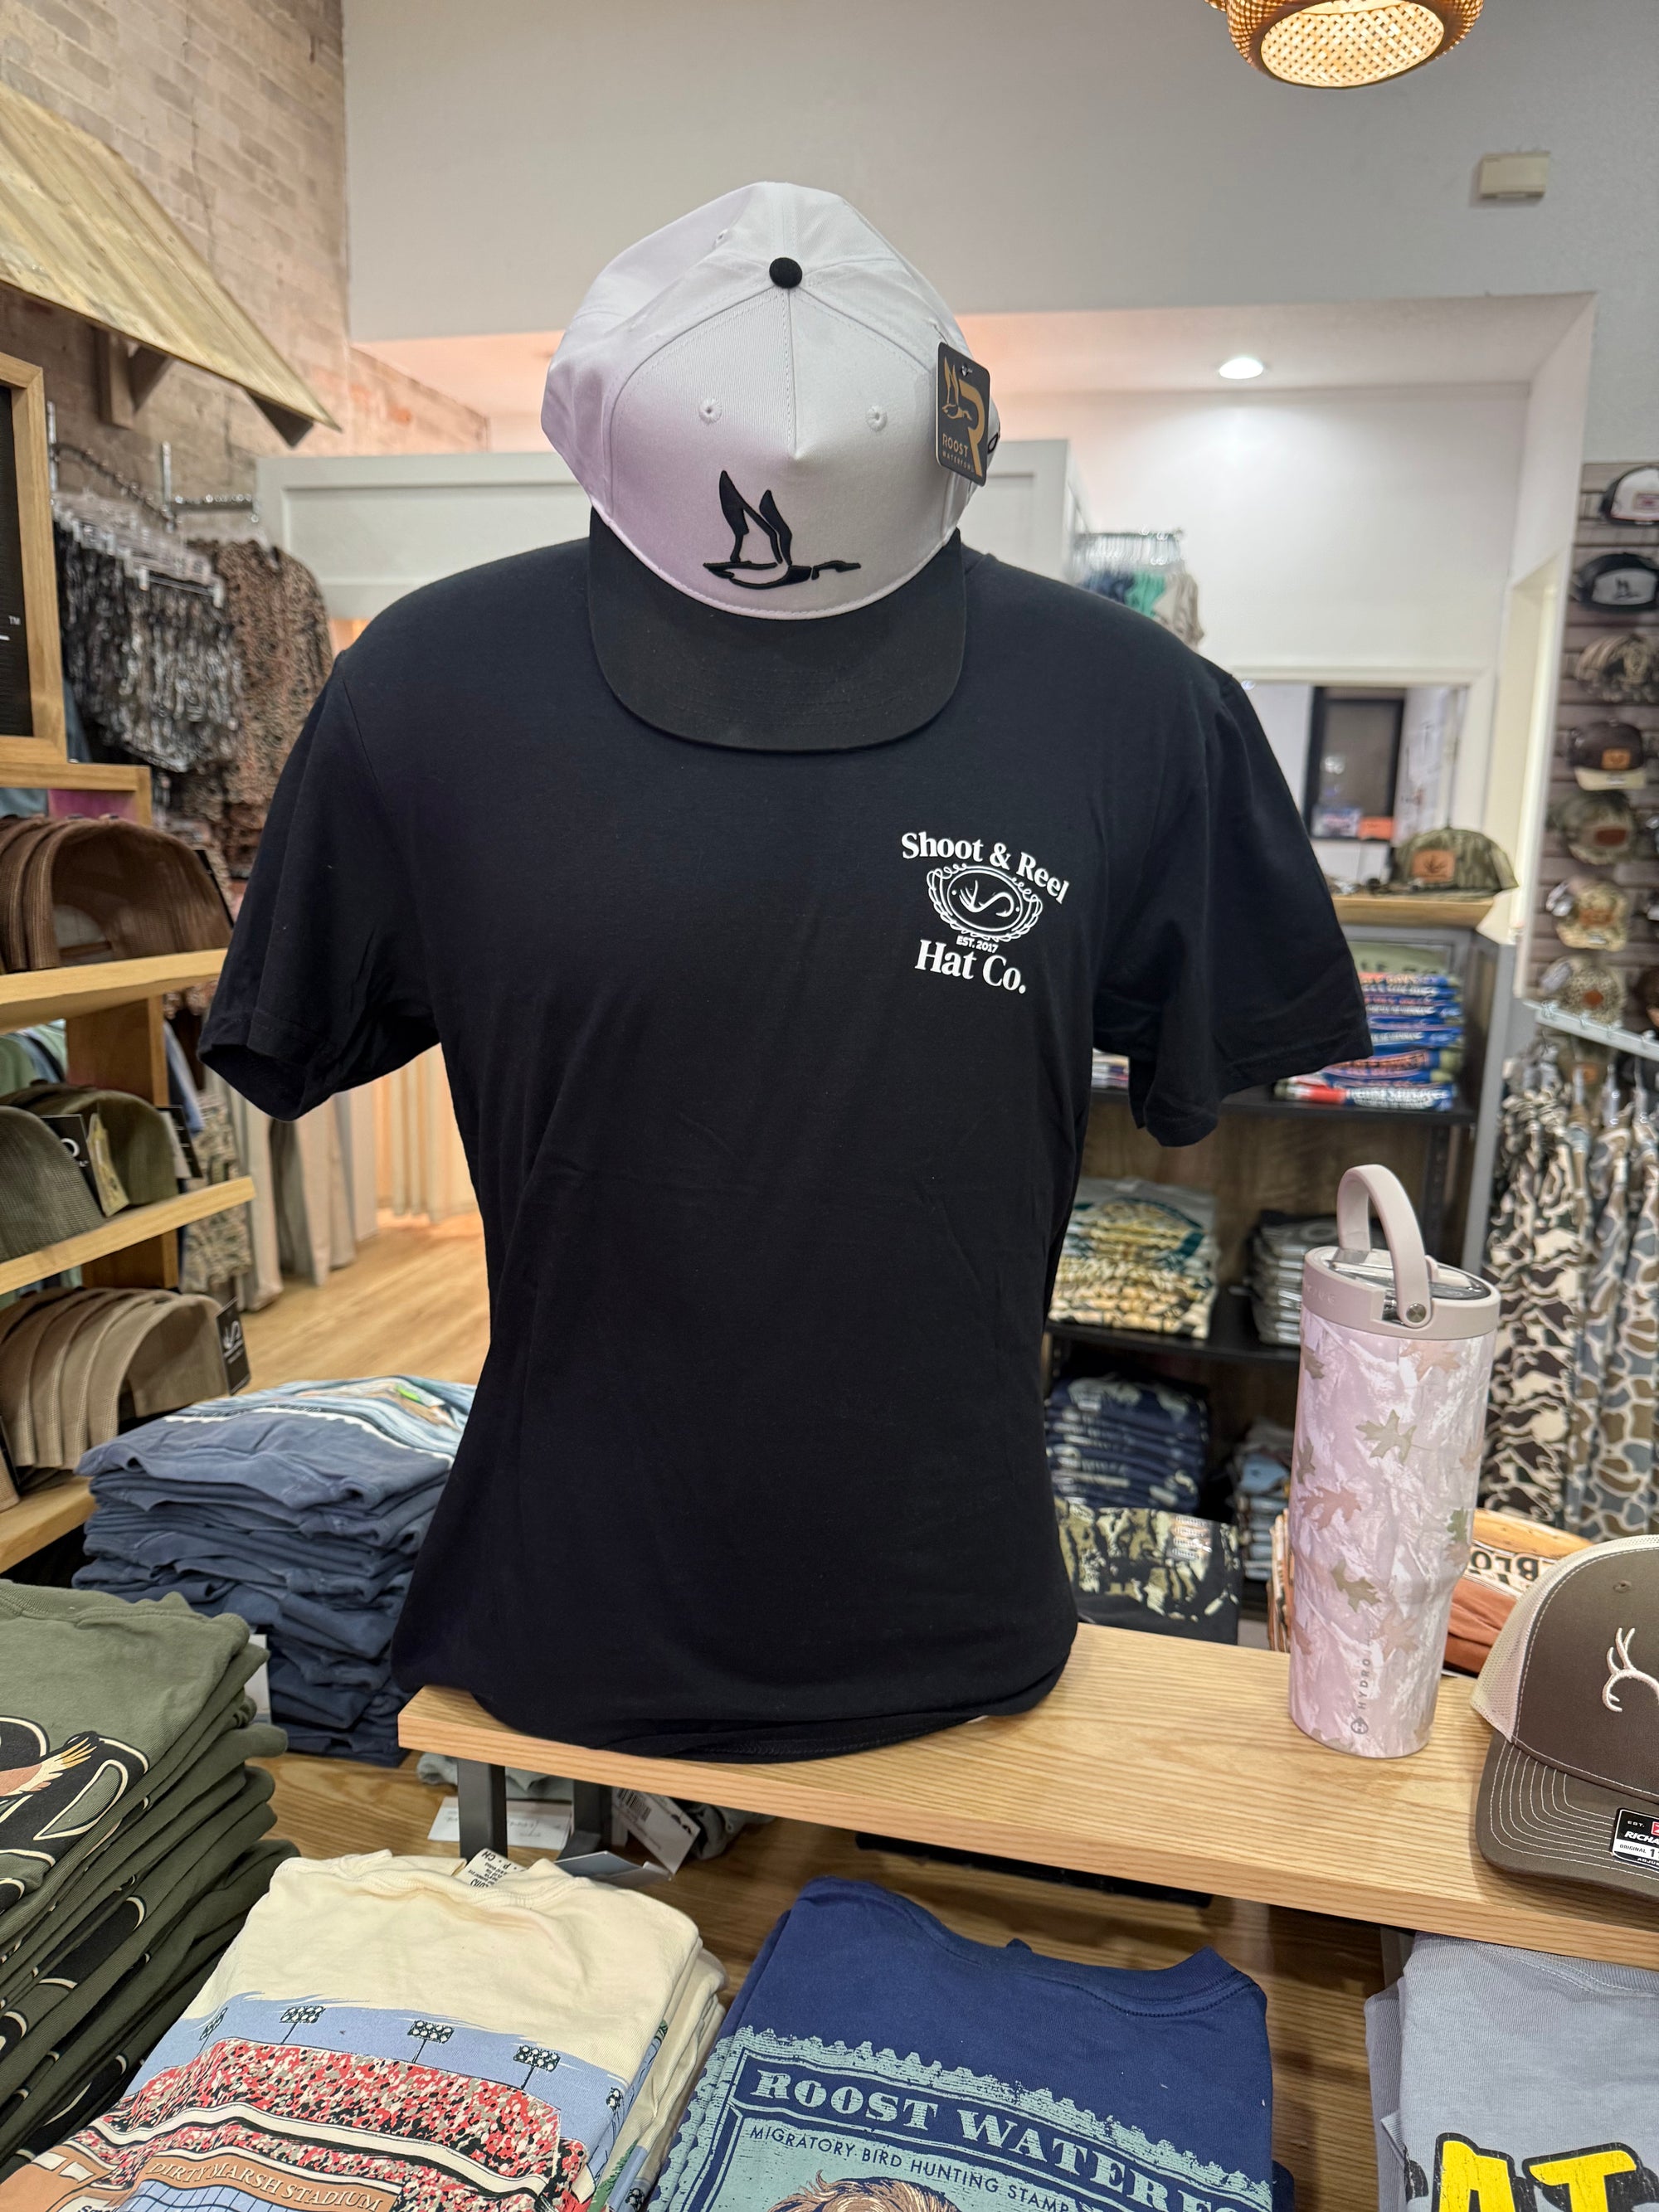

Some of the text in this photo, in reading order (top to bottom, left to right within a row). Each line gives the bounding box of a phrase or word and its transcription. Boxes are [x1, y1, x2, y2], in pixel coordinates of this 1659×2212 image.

[942, 433, 968, 458] ROOST
[8, 615, 22, 625] TM
[901, 831, 1070, 905] Shoot & Reel
[914, 939, 1027, 994] Hat Co.
[956, 936, 999, 954] EST. 2017
[1619, 1844, 1647, 1854] ORIGINAL
[750, 2069, 938, 2131] ROOST
[146, 2161, 382, 2212] DIRTY MARSH STADIUM
[750, 2125, 1069, 2212] MIGRATORY BIRD HUNTING STAMP
